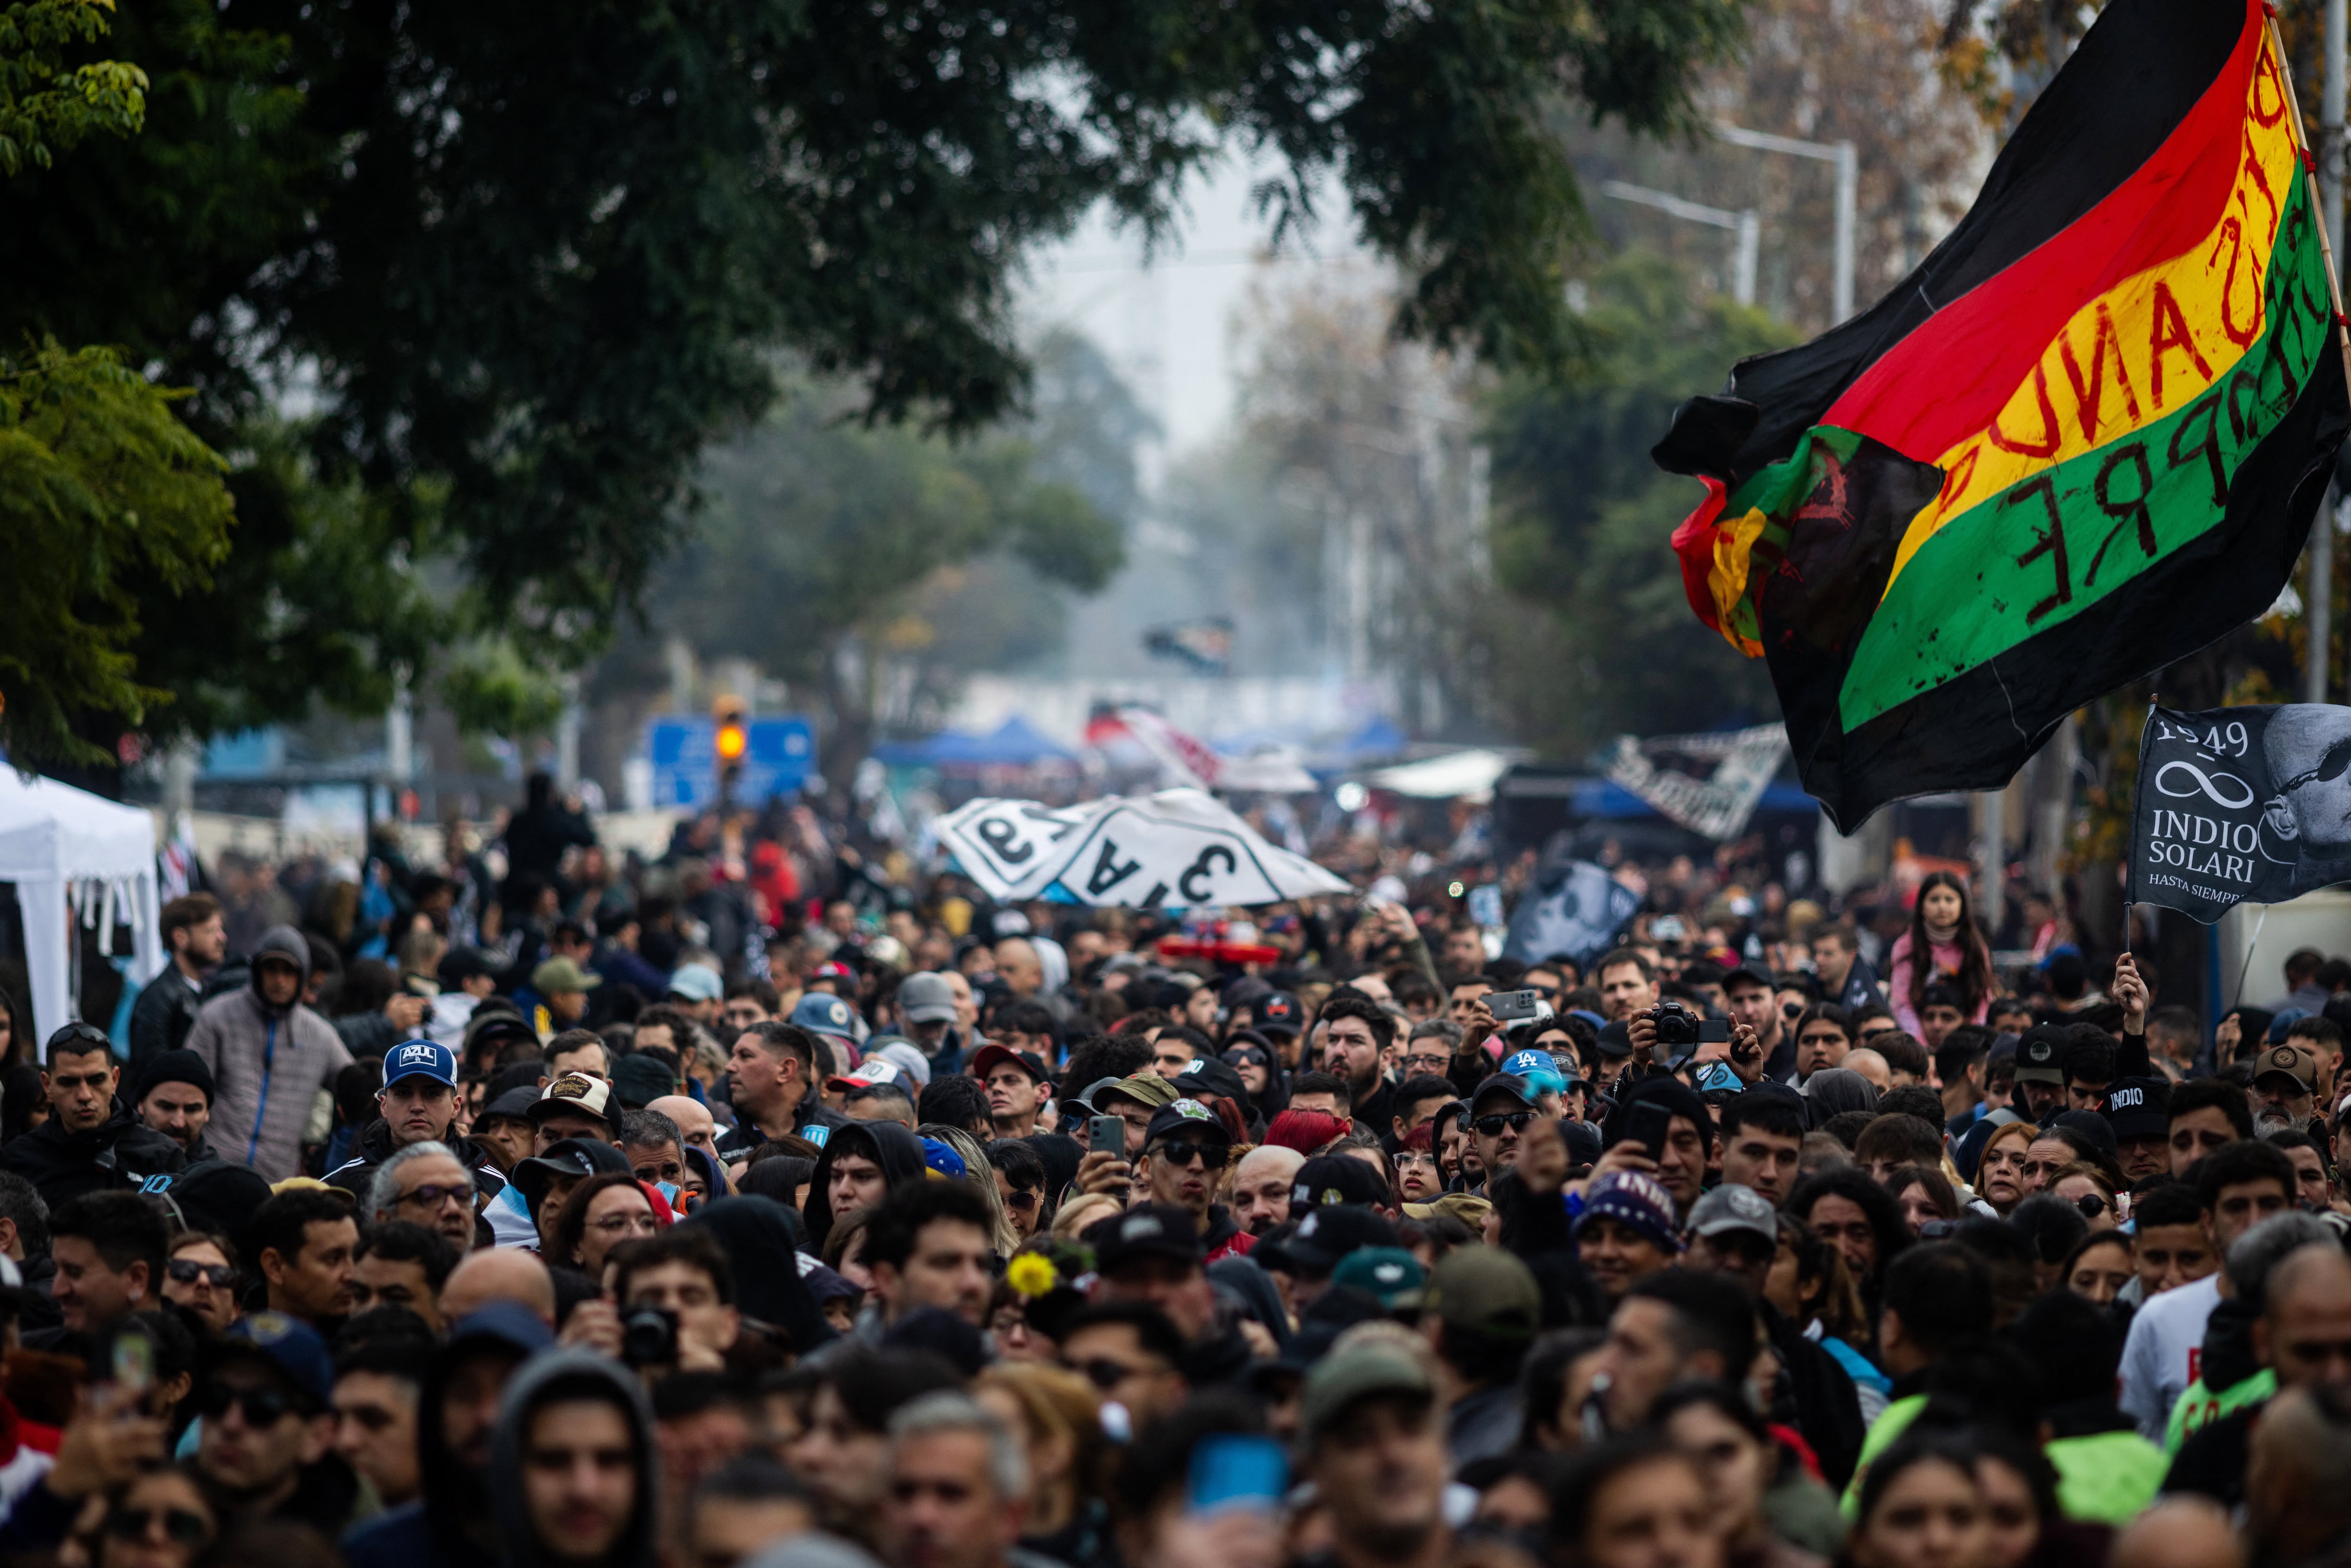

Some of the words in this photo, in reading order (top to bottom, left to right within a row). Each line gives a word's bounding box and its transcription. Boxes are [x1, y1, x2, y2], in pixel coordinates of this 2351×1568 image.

[2151, 810, 2257, 853] INDIO
[2149, 842, 2255, 883] SOLARI
[2149, 874, 2189, 892] HASTA
[2191, 884, 2248, 904] SIEMPR
[402, 1046, 434, 1059] AZUL
[1517, 1052, 1538, 1068] LA
[2110, 1087, 2143, 1111] INDIO
